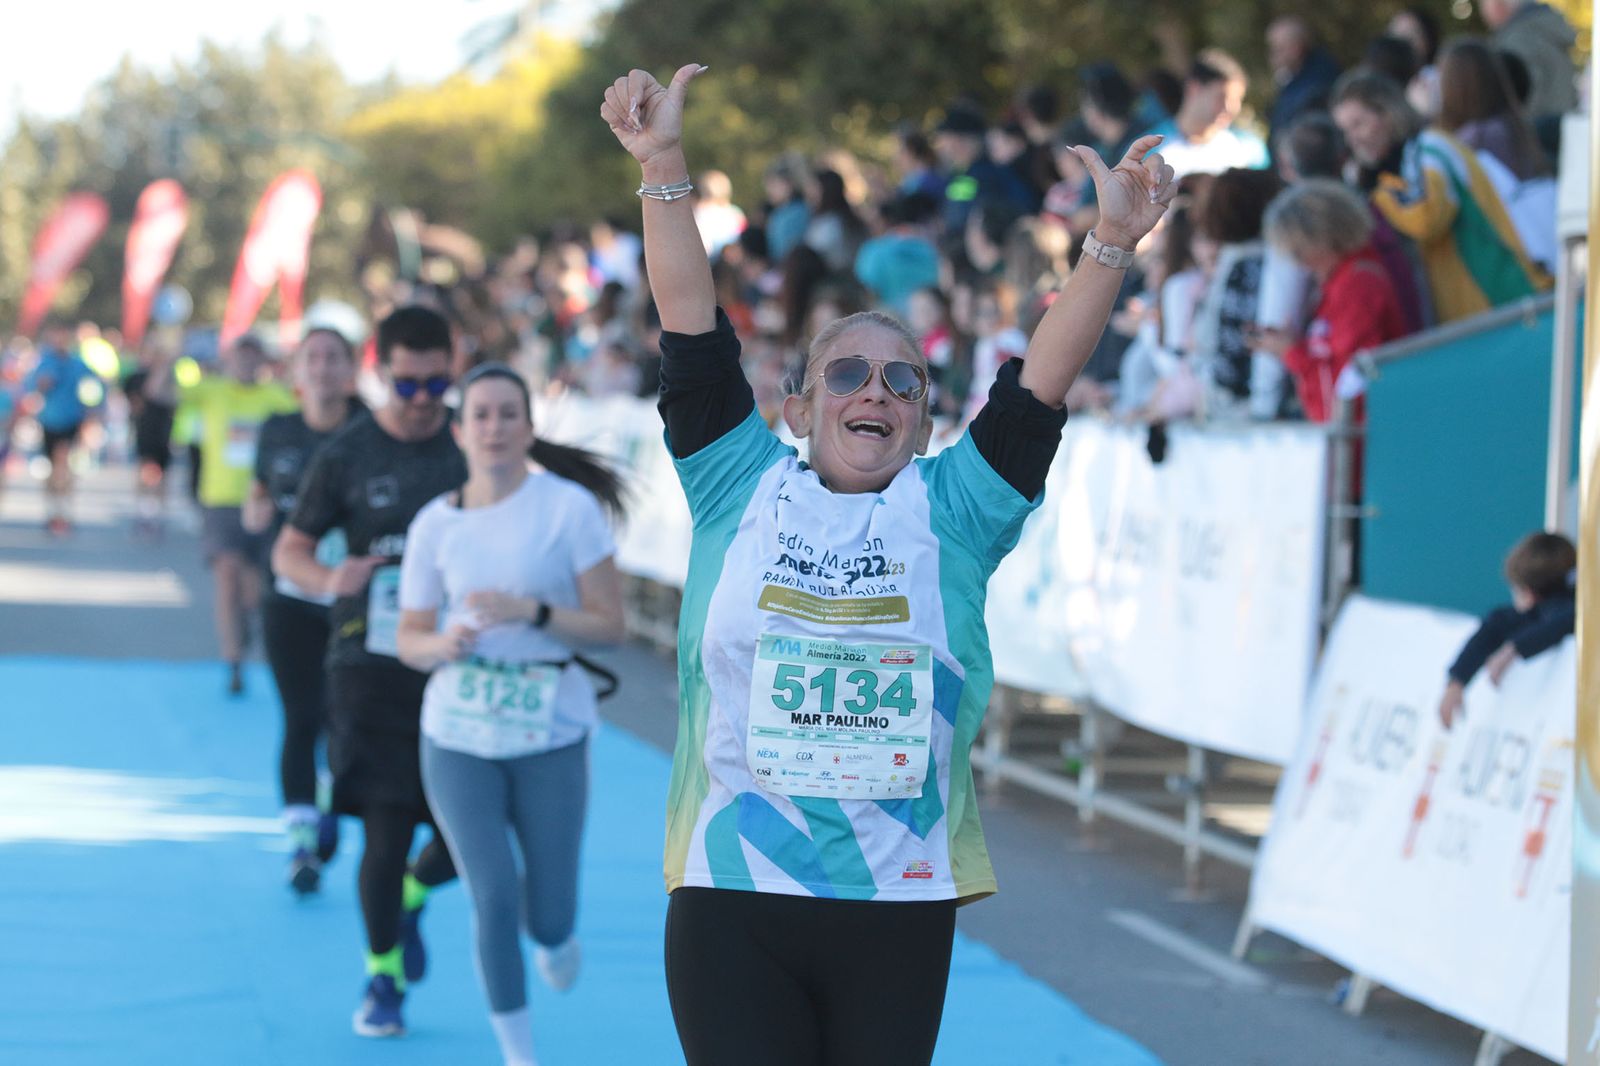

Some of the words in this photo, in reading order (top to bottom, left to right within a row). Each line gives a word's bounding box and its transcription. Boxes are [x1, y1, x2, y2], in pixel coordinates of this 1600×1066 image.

[808, 584, 838, 596] RUIZ
[806, 649, 842, 660] Almería
[842, 652, 867, 662] 2022
[457, 671, 541, 712] 5126
[771, 663, 917, 717] 5134
[790, 712, 824, 726] MAR
[826, 714, 890, 729] PAULINO
[757, 749, 779, 759] NEXA
[795, 751, 815, 761] CDX
